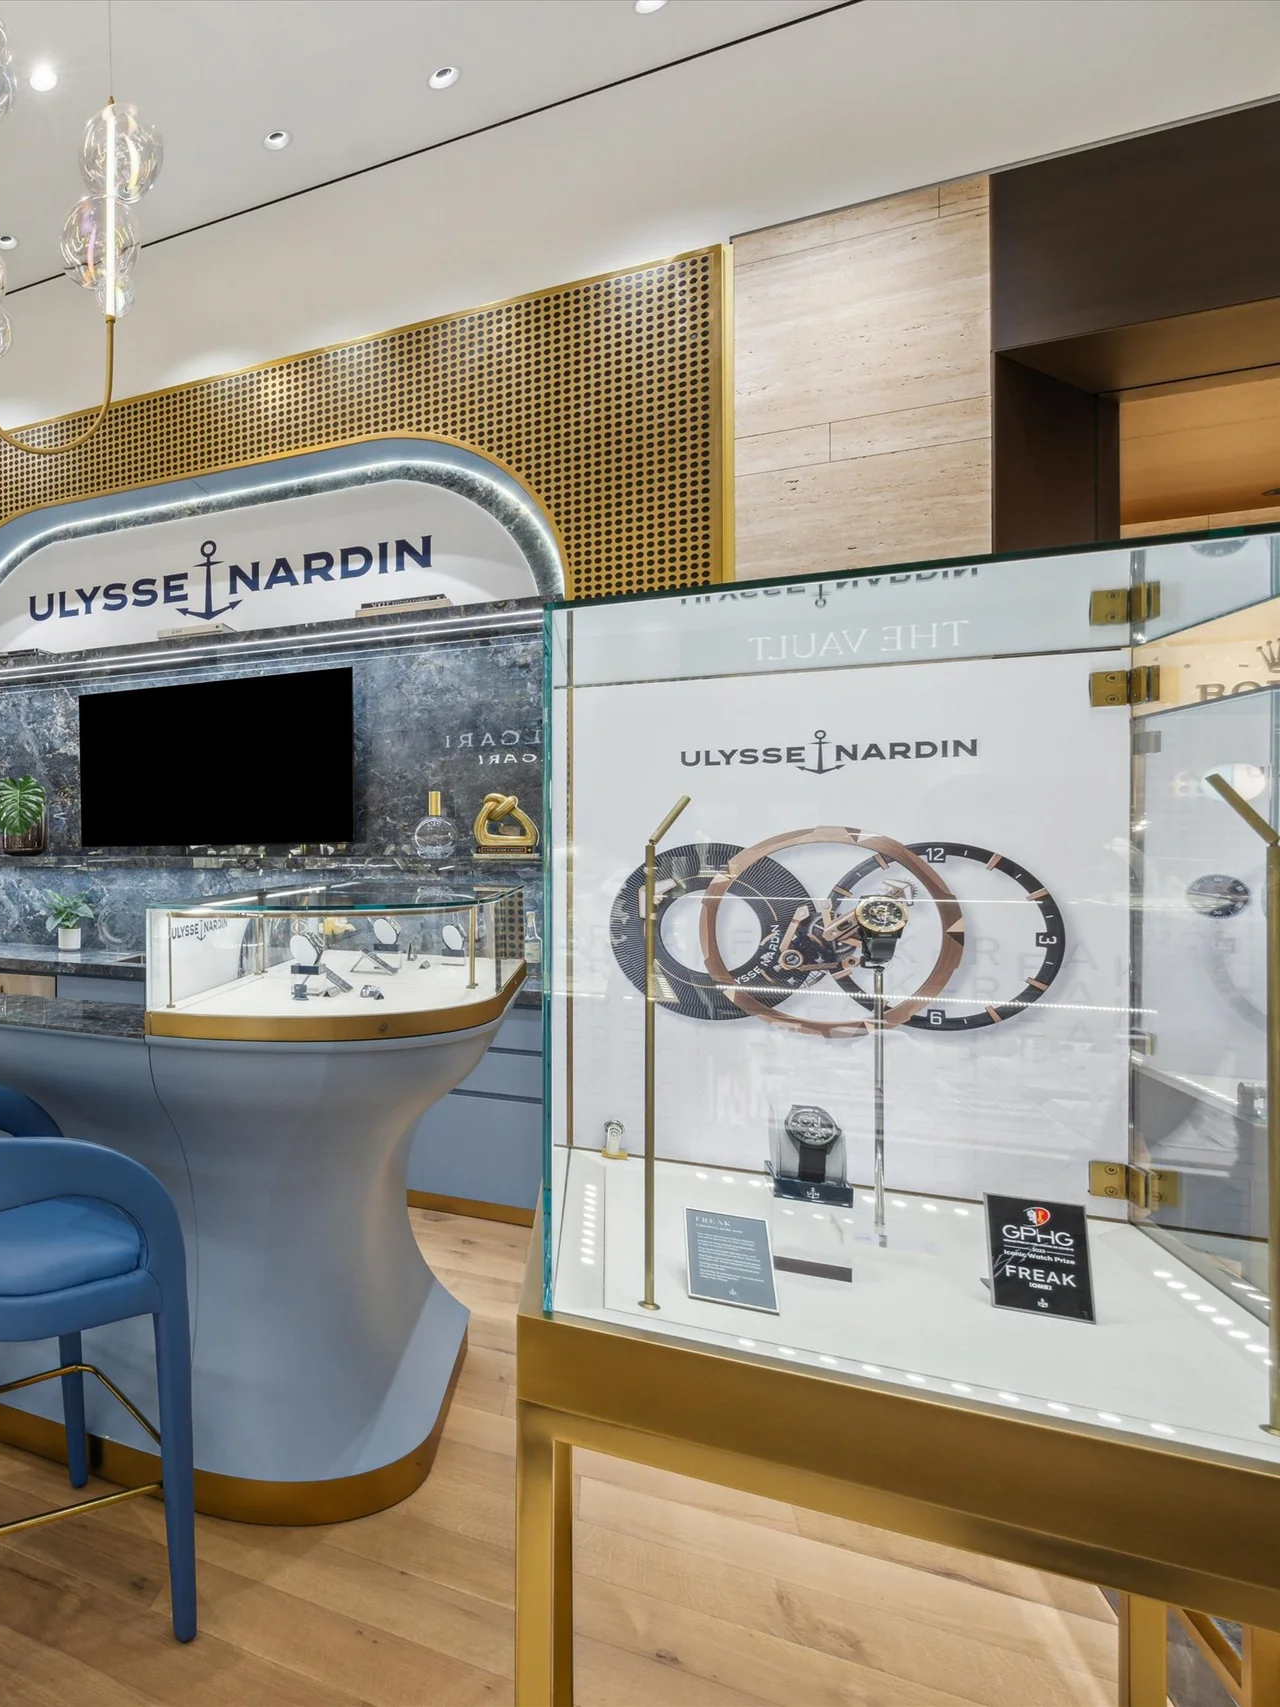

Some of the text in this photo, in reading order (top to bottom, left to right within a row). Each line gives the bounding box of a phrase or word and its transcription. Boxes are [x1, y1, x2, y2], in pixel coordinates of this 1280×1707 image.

[29, 535, 432, 622] ULYSSE NARDIN
[680, 738, 978, 767] ULYSSE NARDIN
[926, 847, 945, 861] 12
[171, 923, 199, 940] ULYSSE
[1038, 935, 1058, 945] 3
[734, 965, 762, 985] YSSE
[930, 1011, 943, 1025] 6
[1002, 1224, 1074, 1247] GPHG
[1003, 1249, 1076, 1265] Iconic Watch Prize
[1005, 1264, 1077, 1288] FREAK
